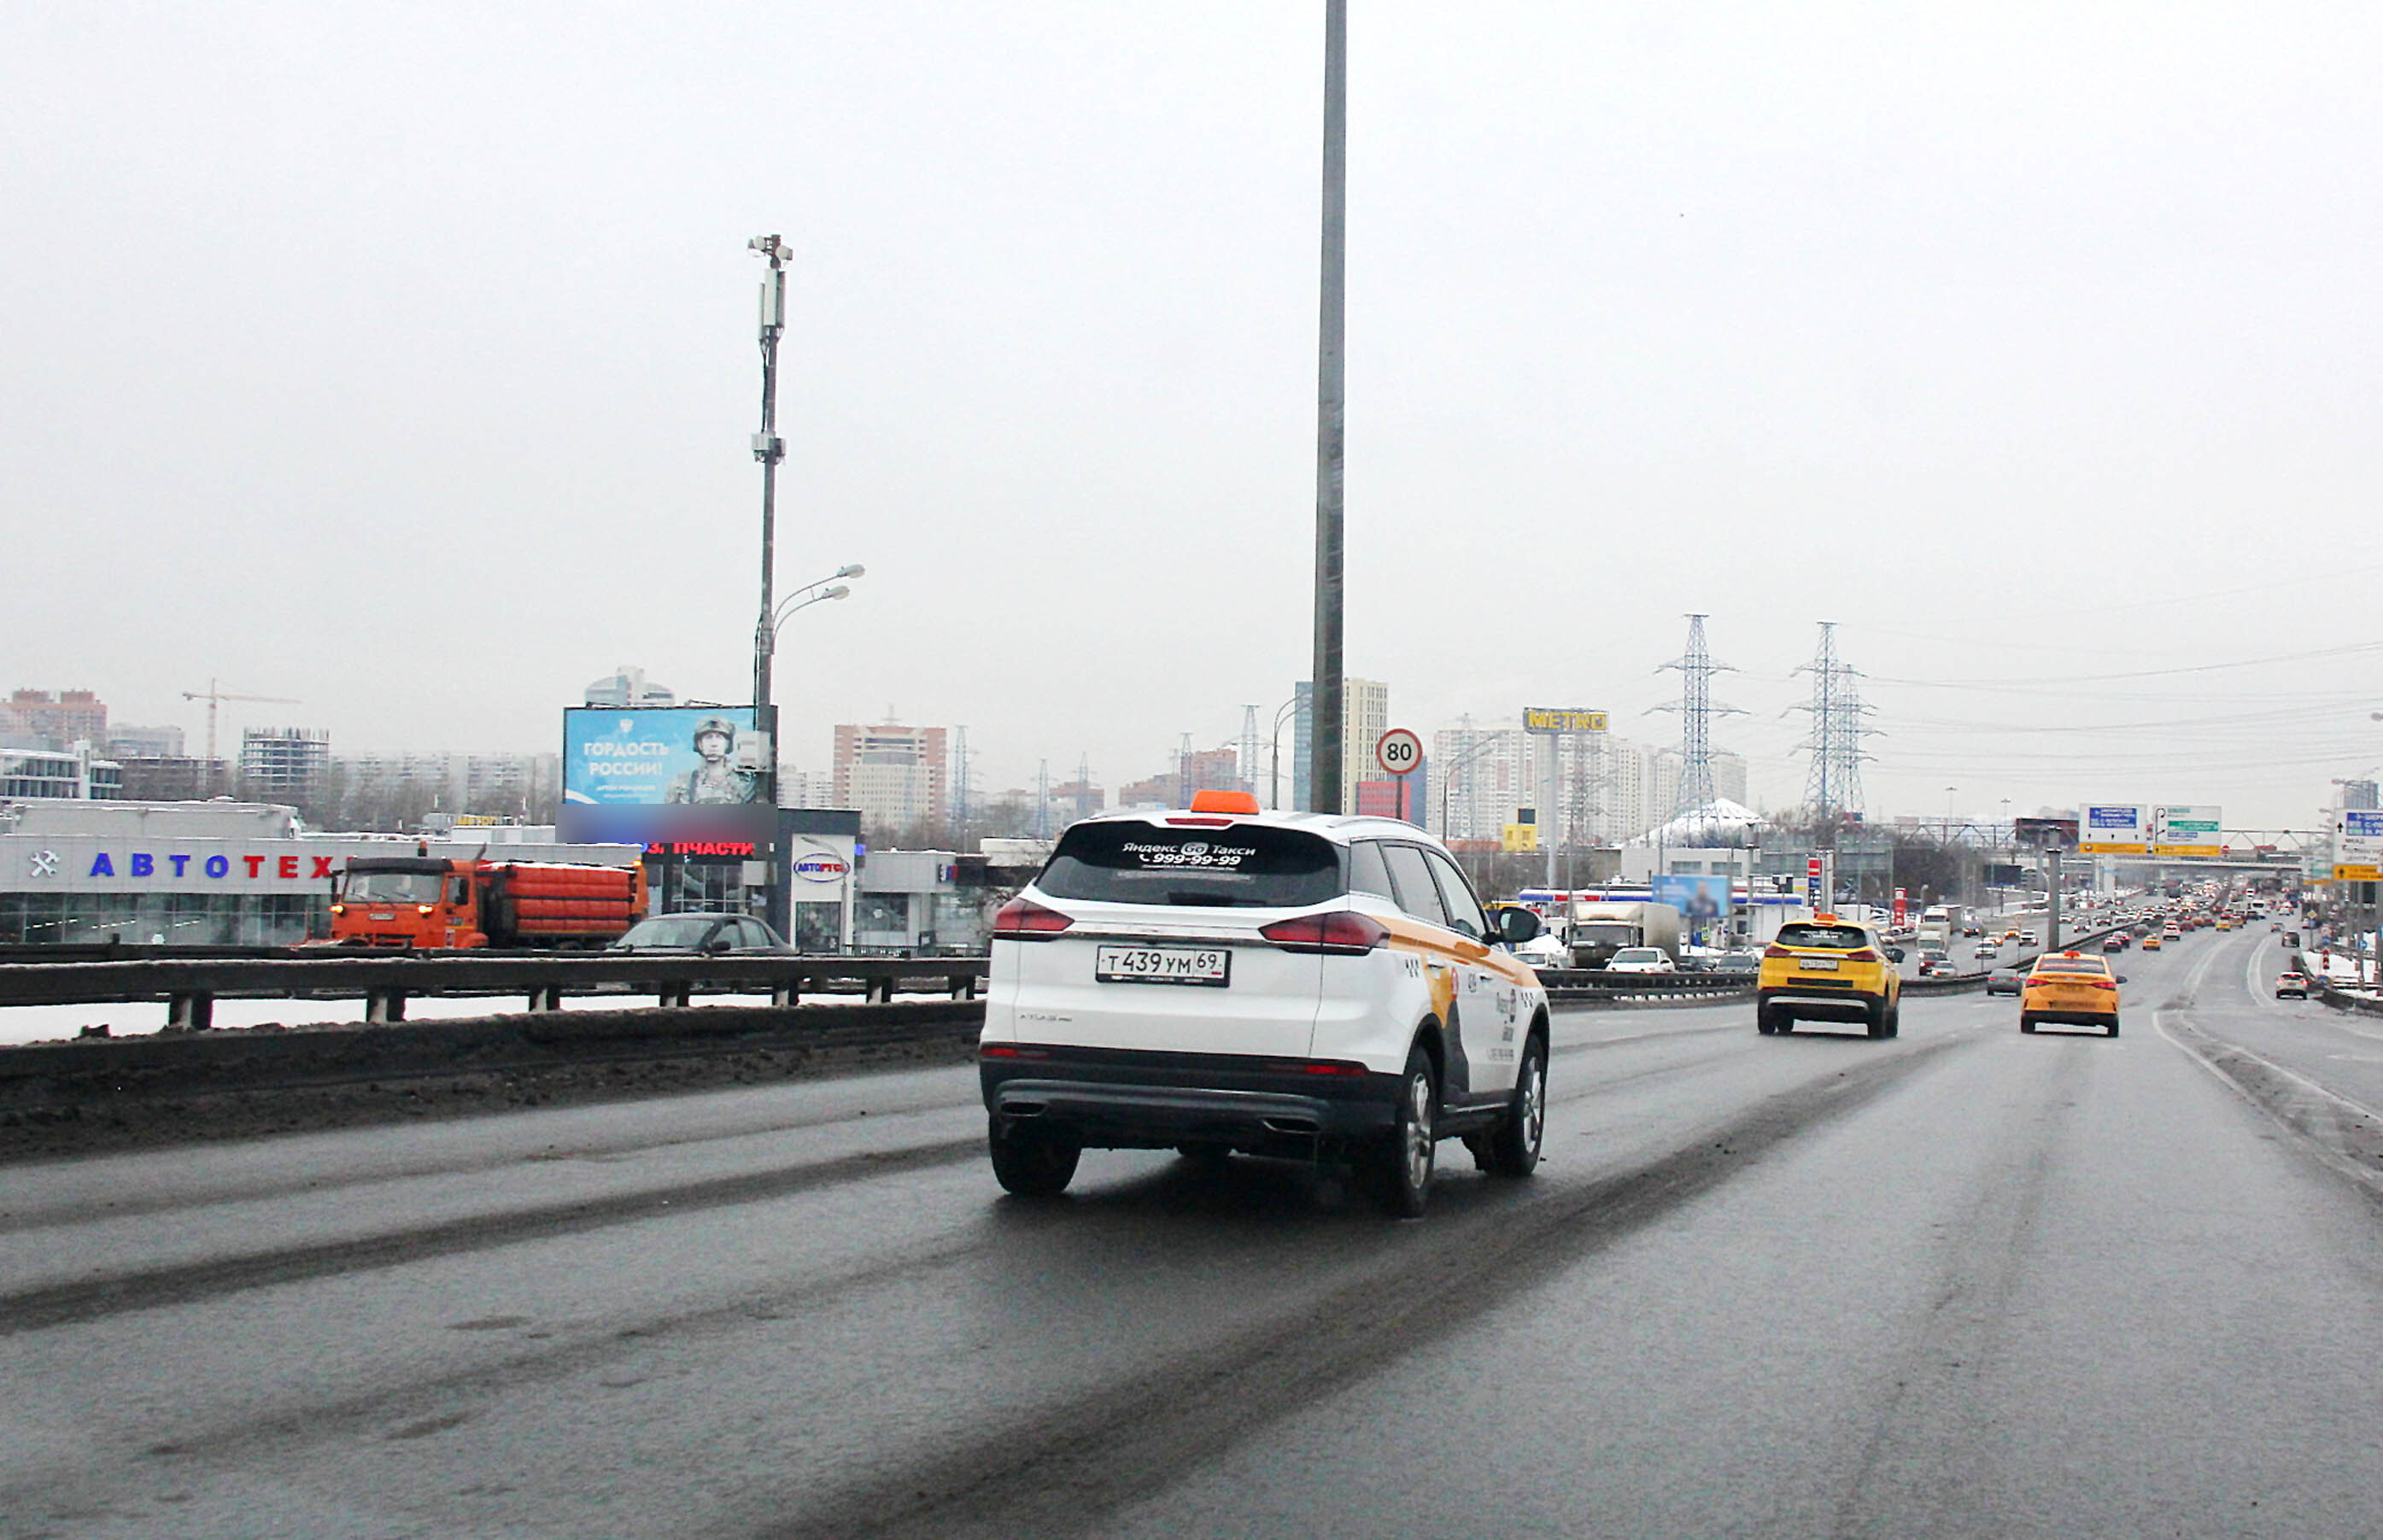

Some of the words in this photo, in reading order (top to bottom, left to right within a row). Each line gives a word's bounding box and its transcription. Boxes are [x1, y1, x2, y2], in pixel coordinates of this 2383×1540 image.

[1527, 711, 1607, 730] METRO
[583, 742, 669, 757] ГОРДОСТЬ
[1386, 743, 1412, 761] 80
[589, 762, 663, 776] РОССИИ!
[1122, 842, 1179, 852] Яндекс
[1213, 845, 1256, 856] Такси
[90, 852, 356, 879] АВТОТЕХ
[1153, 853, 1241, 865] 999-99-99
